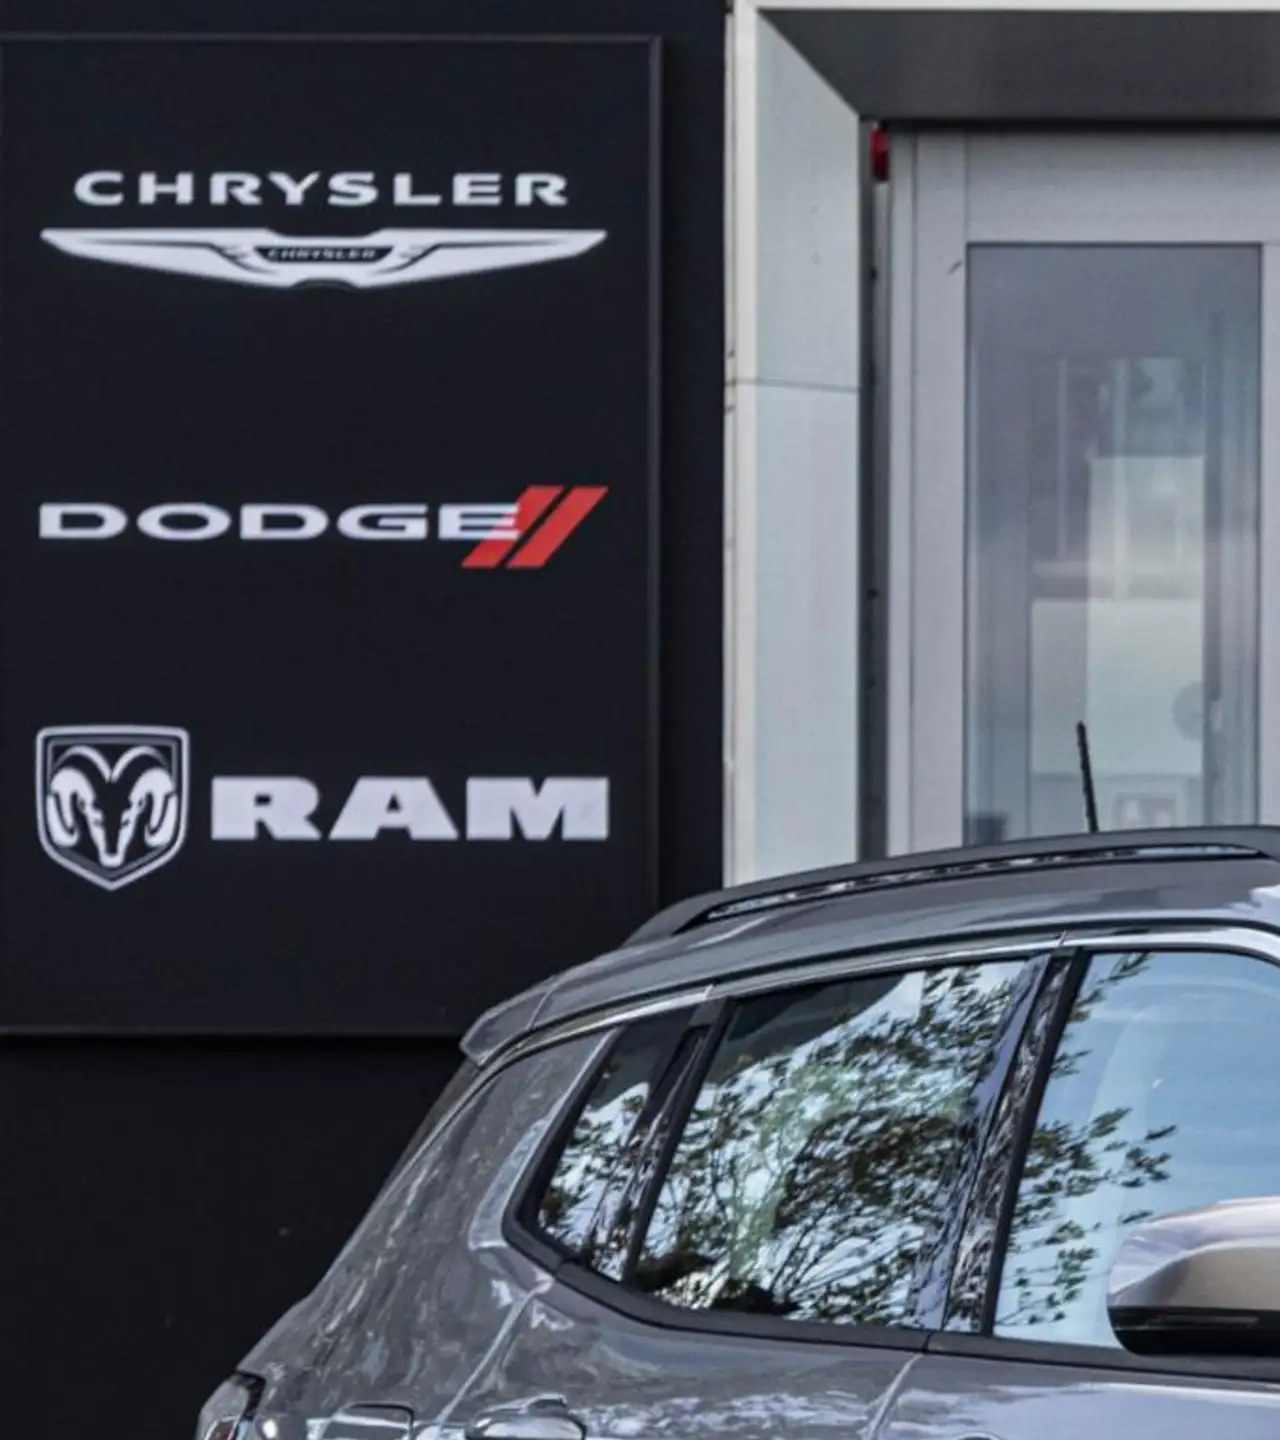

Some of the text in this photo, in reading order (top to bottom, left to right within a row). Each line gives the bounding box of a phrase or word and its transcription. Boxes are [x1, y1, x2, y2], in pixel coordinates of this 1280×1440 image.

[74, 171, 567, 206] CHRYSLER
[267, 247, 376, 260] CHRYSLER
[39, 502, 522, 541] DODGE
[211, 776, 609, 841] RAM
